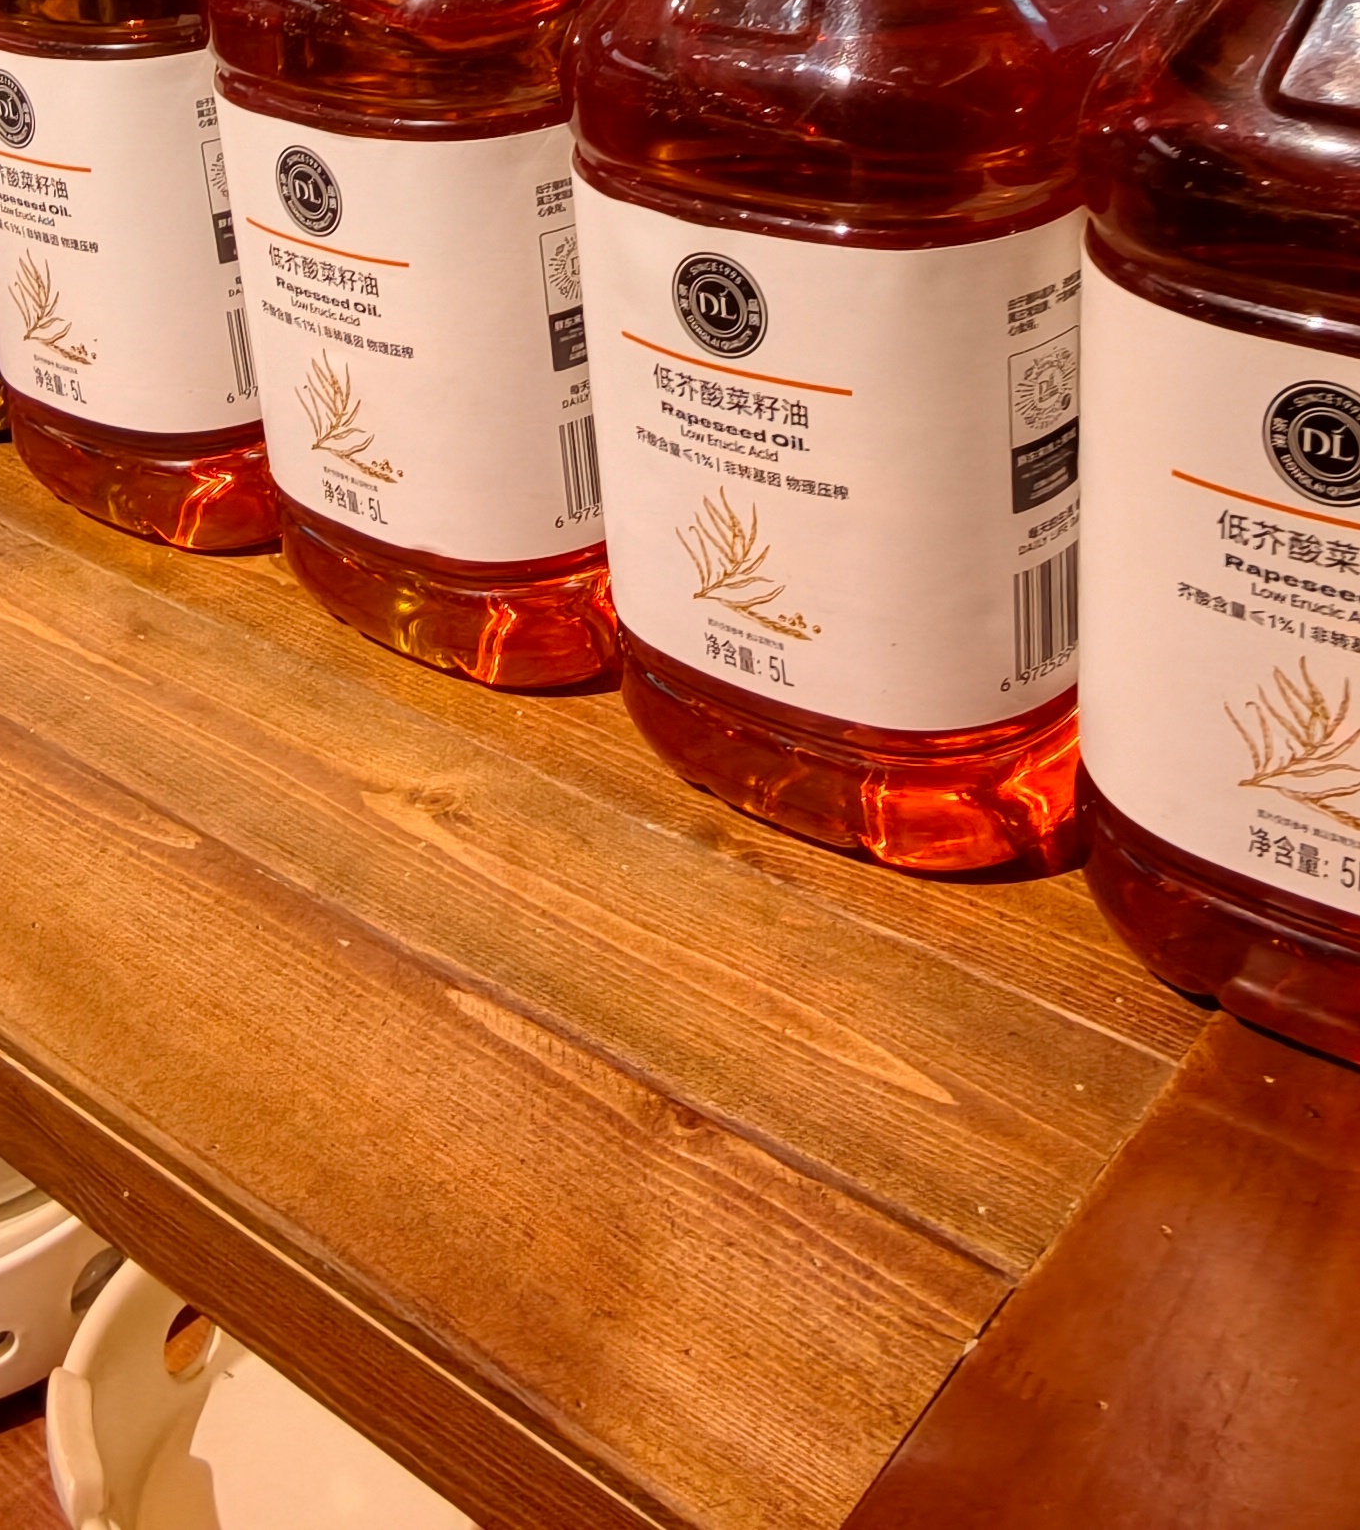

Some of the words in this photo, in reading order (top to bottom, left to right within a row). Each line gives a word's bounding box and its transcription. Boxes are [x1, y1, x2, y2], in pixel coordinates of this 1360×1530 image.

[353, 301, 382, 318] Oil.
[226, 391, 235, 404] 6
[652, 362, 810, 430] 低芥酸菜籽油
[660, 399, 767, 445] Rapeseed
[771, 433, 811, 453] Oil.
[368, 497, 389, 526] 5L
[555, 515, 565, 529] 6
[769, 655, 795, 687] 5L
[1000, 677, 1011, 692] 6
